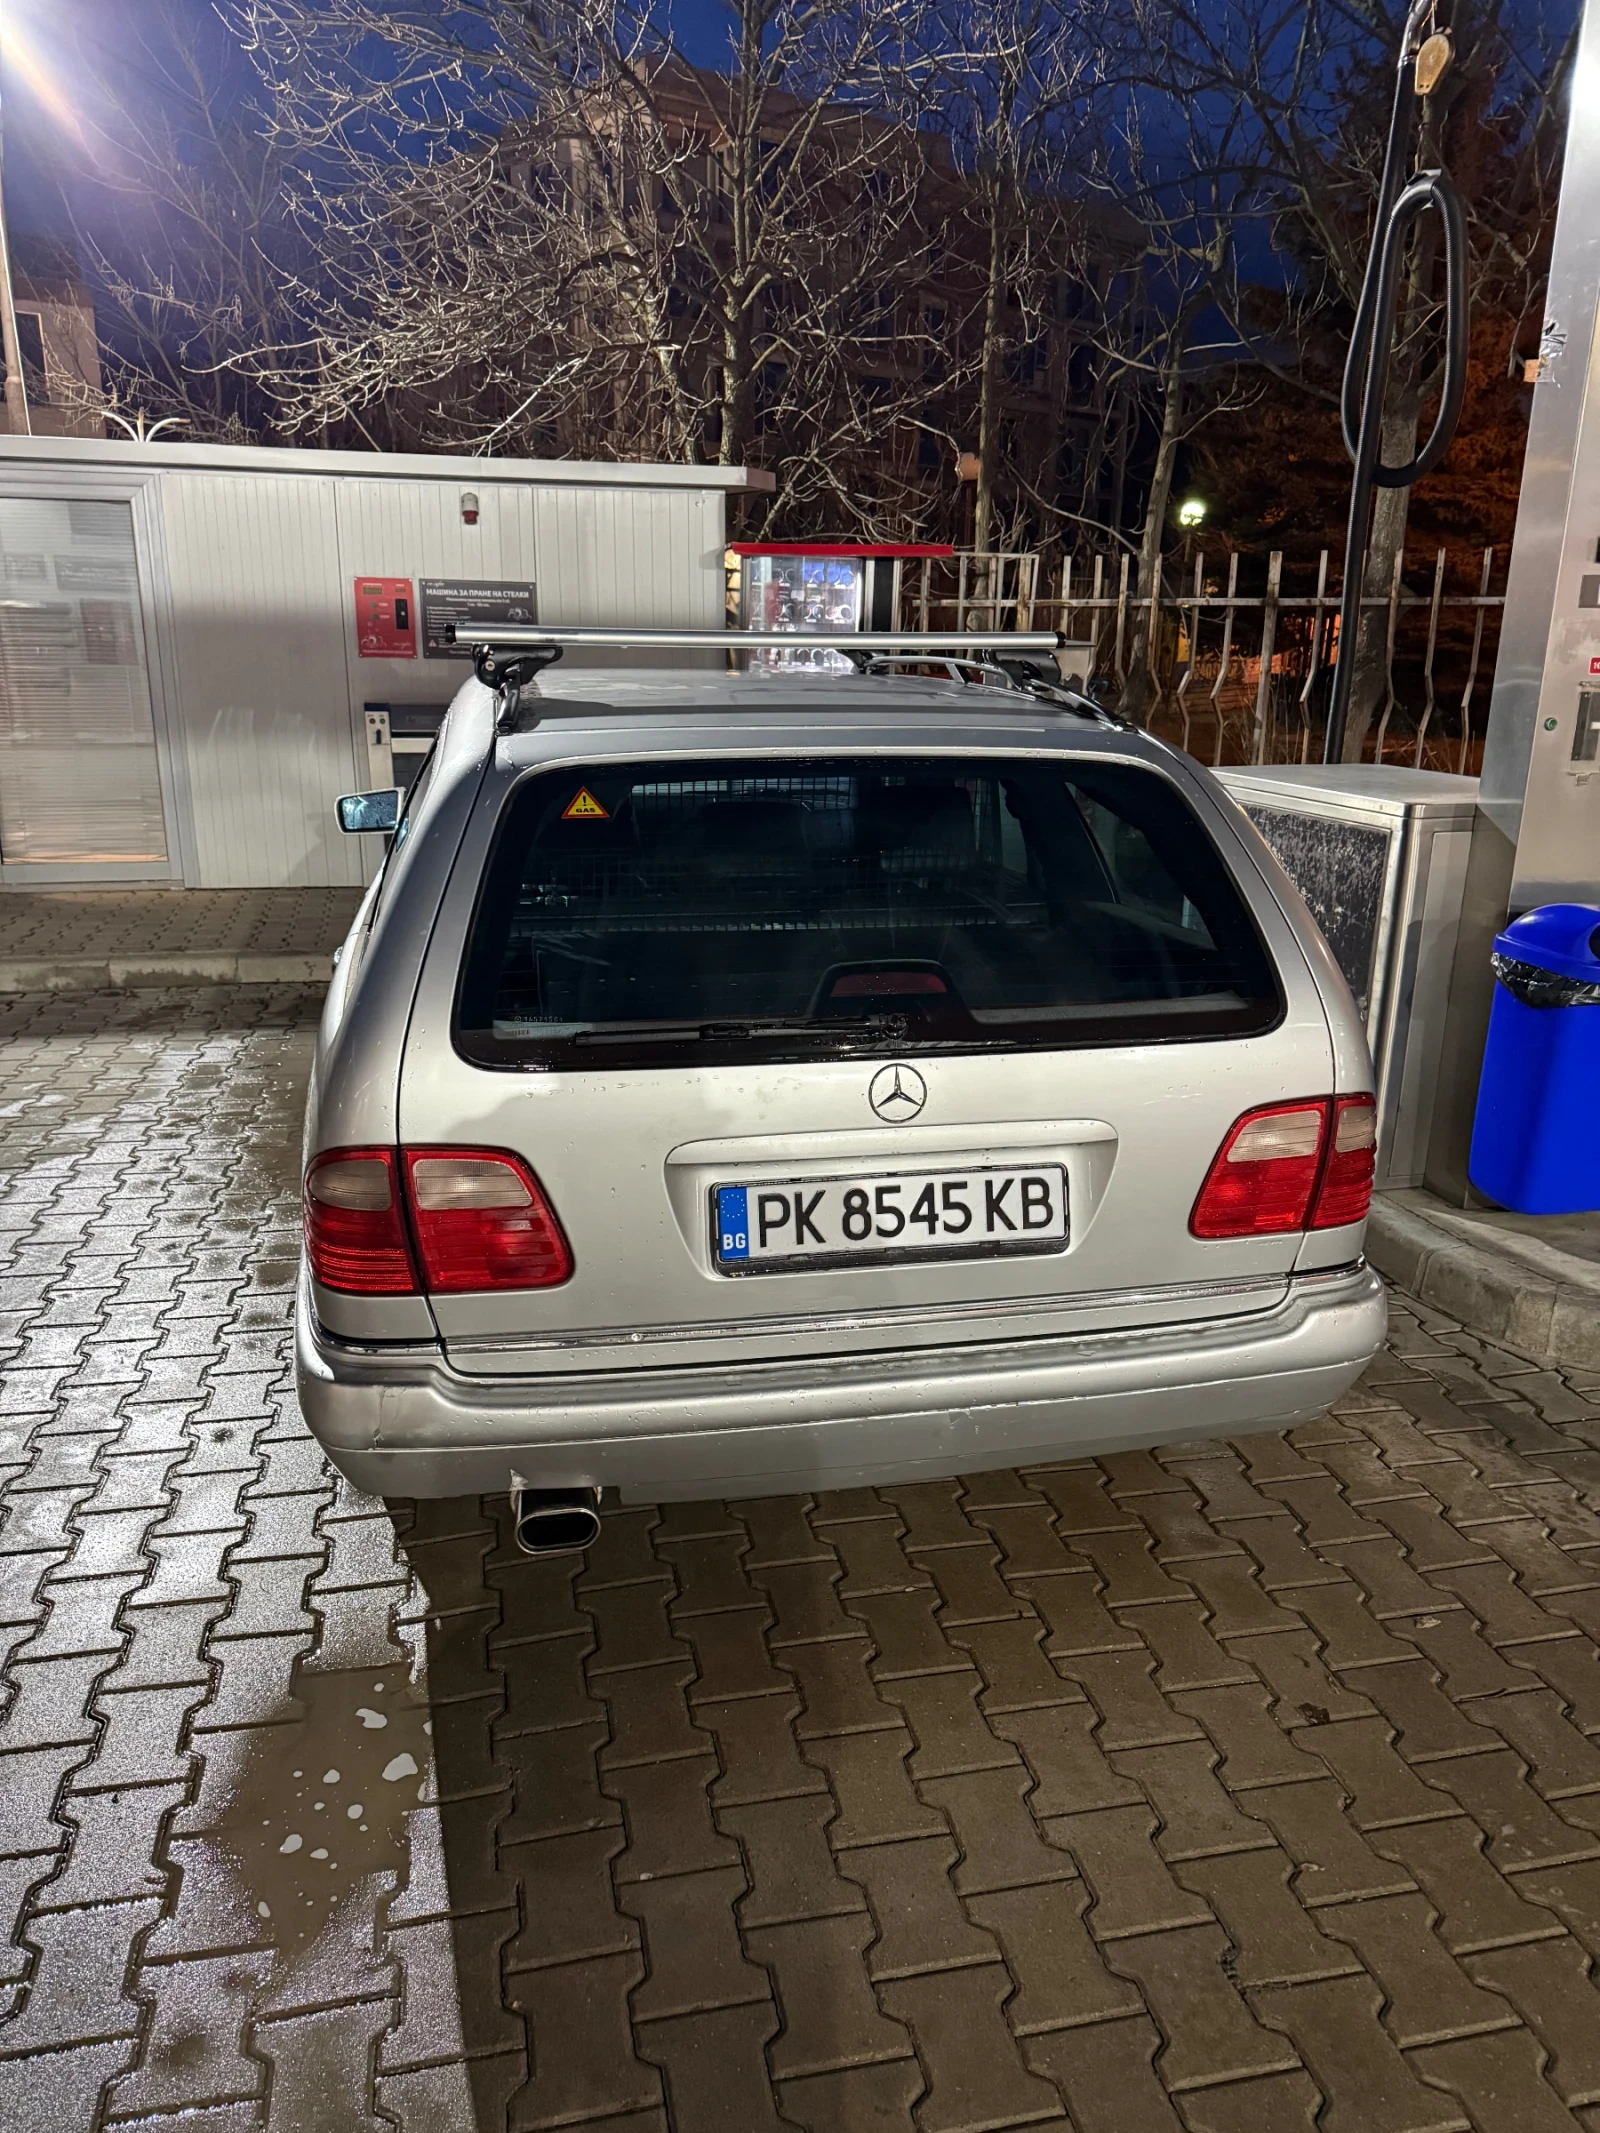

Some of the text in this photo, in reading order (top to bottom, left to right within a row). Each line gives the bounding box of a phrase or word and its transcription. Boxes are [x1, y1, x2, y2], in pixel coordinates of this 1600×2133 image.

[426, 588, 459, 596] МАШИНА
[469, 589, 492, 597] ПРАНЕ
[757, 1176, 1054, 1248] PK 8545 KB
[723, 1232, 746, 1250] BG
